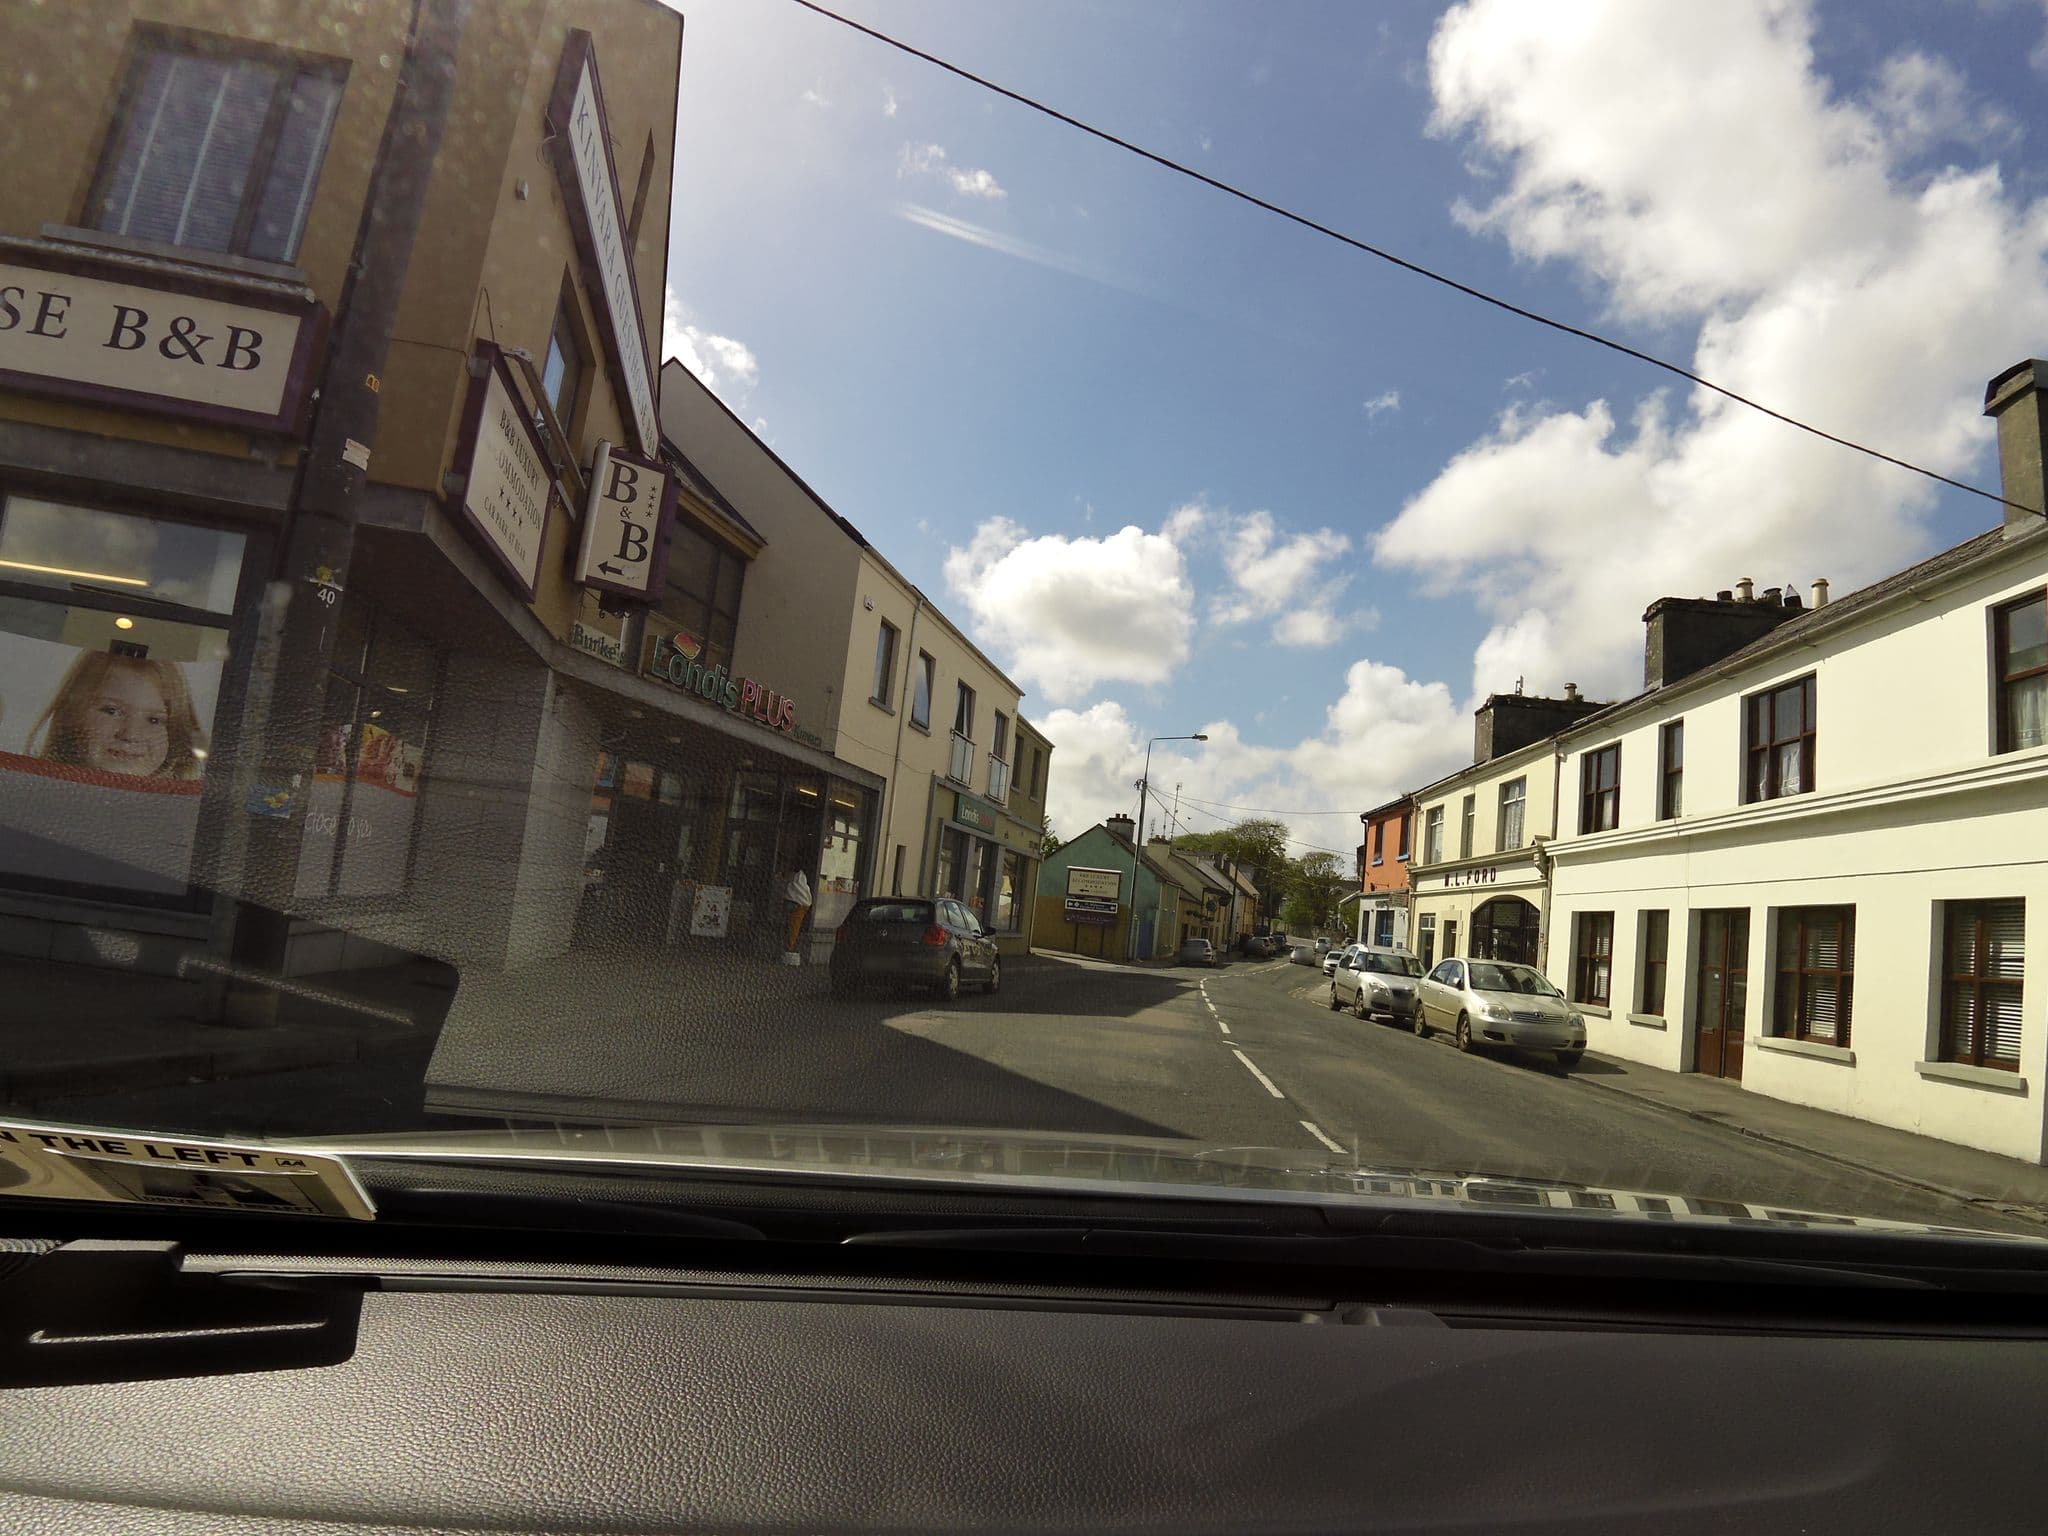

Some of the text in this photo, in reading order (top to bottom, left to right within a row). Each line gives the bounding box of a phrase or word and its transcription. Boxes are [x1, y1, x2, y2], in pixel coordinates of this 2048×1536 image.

[575, 92, 616, 278] KINVARA
[0, 286, 264, 371] SE B&B
[494, 447, 542, 531] OMMODATION
[499, 408, 540, 492] B&B LUXURY
[317, 587, 336, 605] 40
[651, 634, 739, 711] Londis
[740, 677, 797, 734] PLUS
[28, 1133, 133, 1157] THE
[143, 1143, 261, 1167] LEFT
